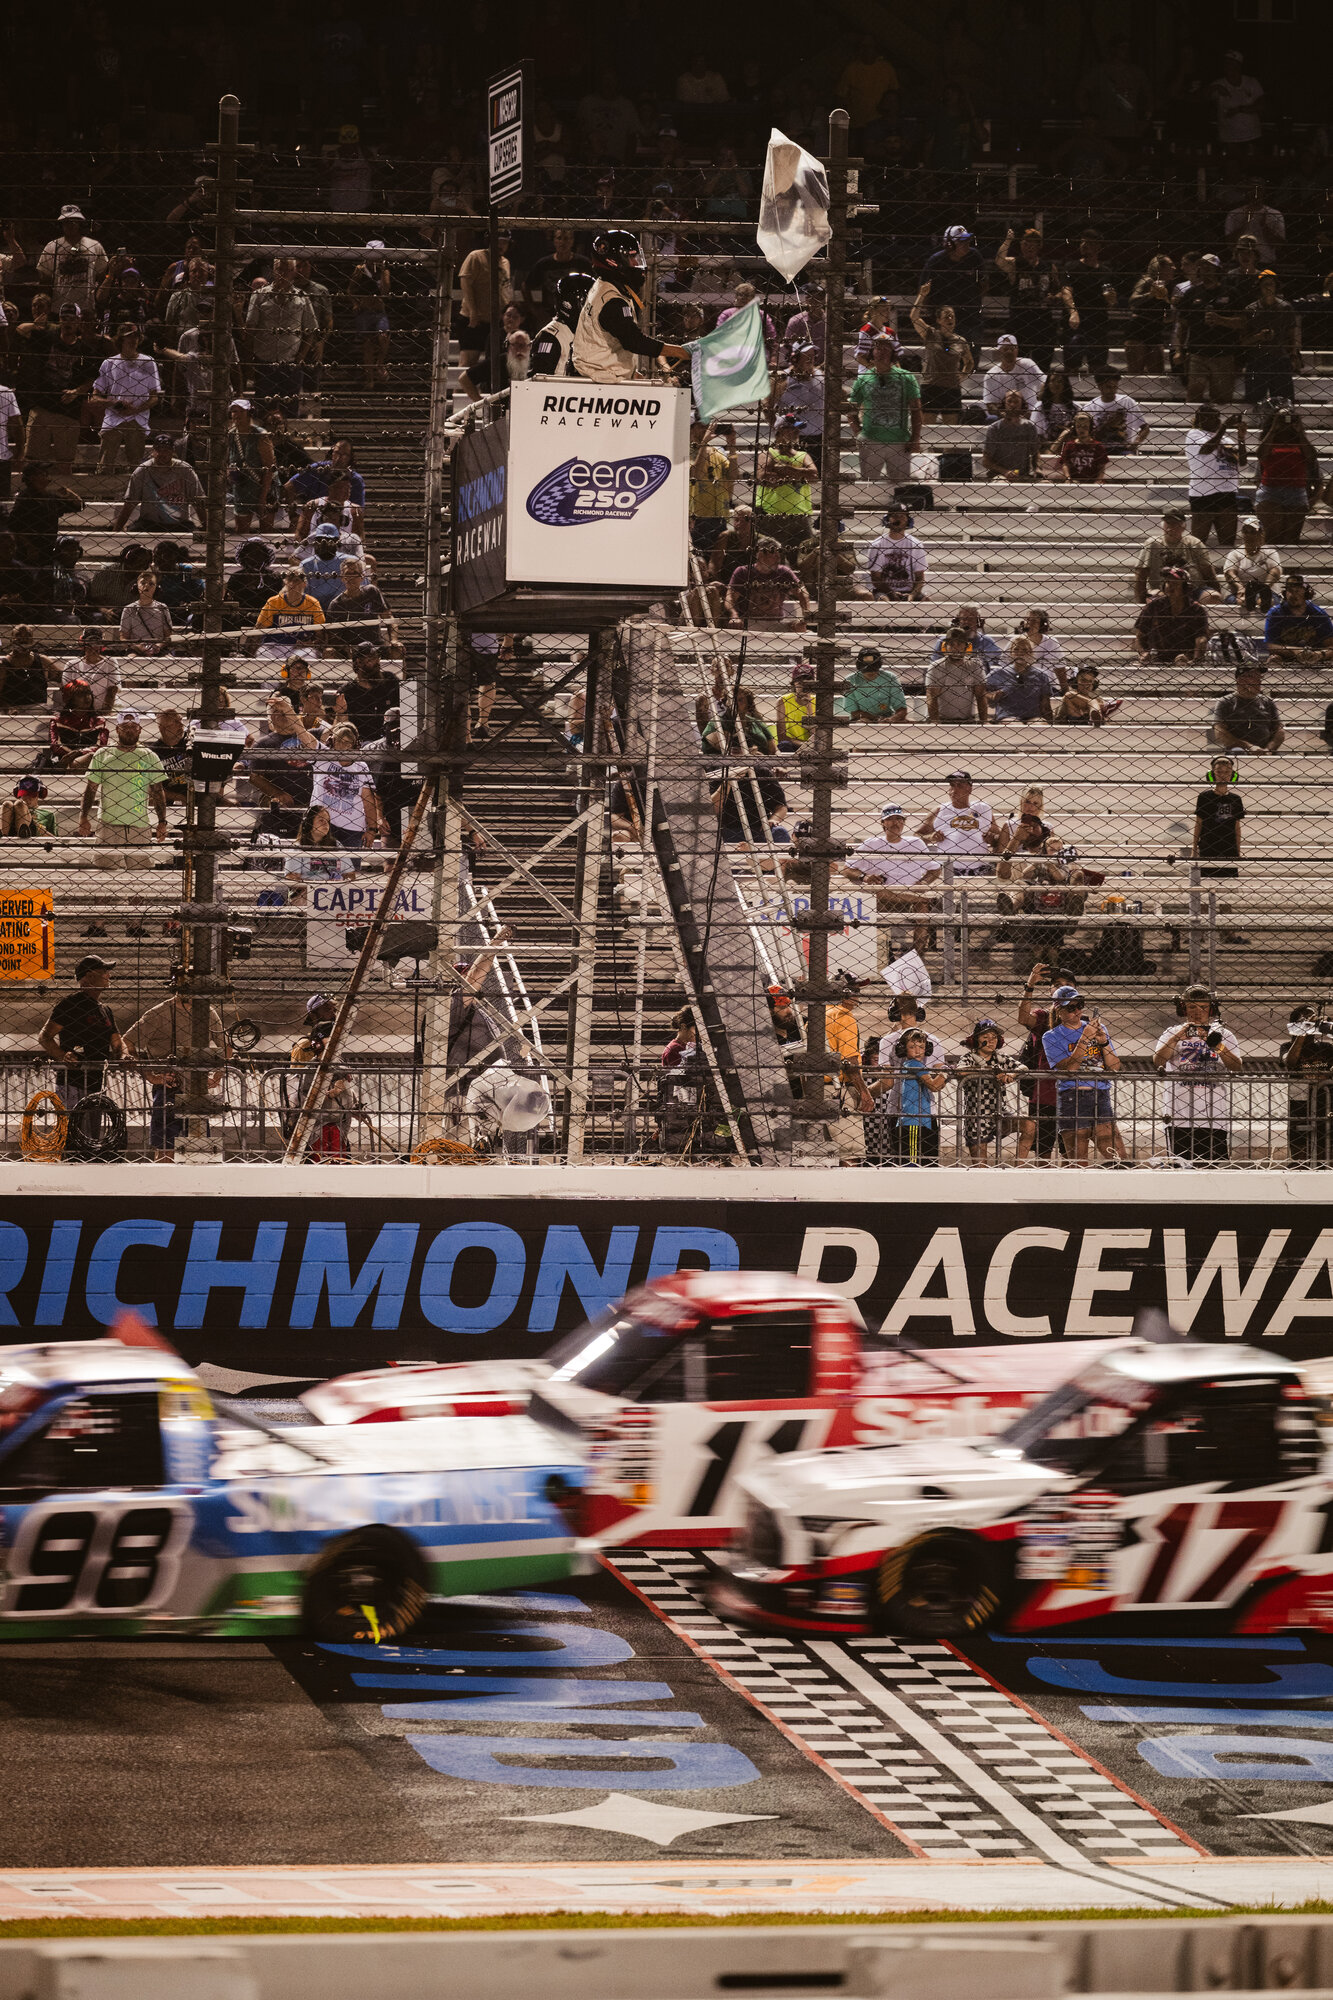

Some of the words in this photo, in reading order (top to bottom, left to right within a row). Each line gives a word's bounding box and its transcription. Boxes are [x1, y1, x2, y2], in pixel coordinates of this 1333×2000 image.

[494, 142, 502, 172] CUP
[543, 396, 661, 416] RICHMOND
[540, 415, 657, 430] RACEWAY
[568, 463, 649, 489] eero
[458, 465, 505, 524] RICHMOND
[574, 489, 637, 509] 250
[456, 514, 503, 566] RACEWAY
[200, 751, 233, 761] WHELEN
[0, 899, 34, 915] ERVED
[313, 888, 425, 912] CAPIAL
[17, 943, 37, 955] THIS
[8, 1504, 186, 1614] 98
[1136, 1498, 1285, 1605] 17
